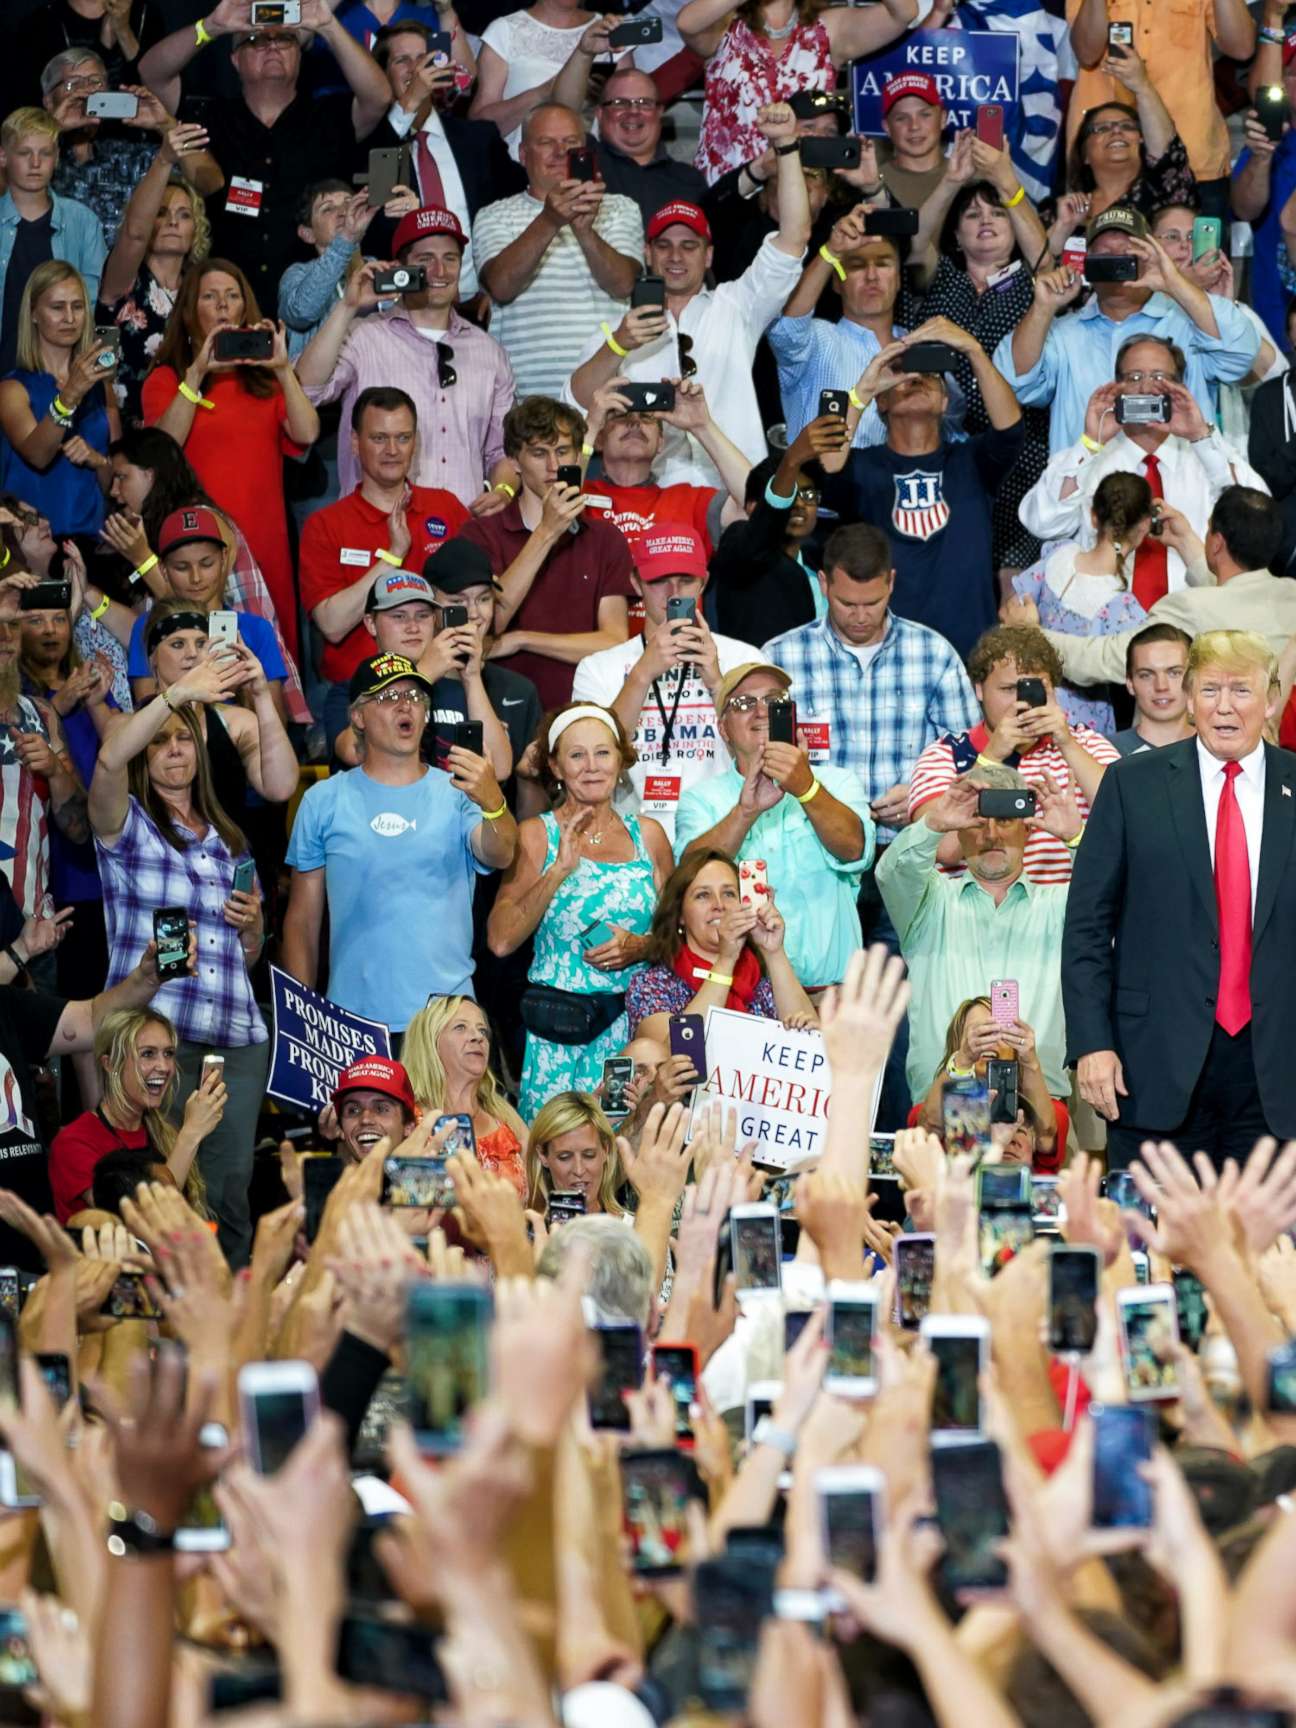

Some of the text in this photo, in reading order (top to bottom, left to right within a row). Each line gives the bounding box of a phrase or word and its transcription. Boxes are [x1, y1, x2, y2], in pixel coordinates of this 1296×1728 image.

[907, 46, 966, 65] KEEP
[860, 72, 1013, 101] ARICA
[183, 511, 199, 530] E
[646, 535, 696, 548] MAKE AMERICA
[648, 546, 672, 555] GREAT
[284, 987, 377, 1055] PROMISES
[762, 1042, 825, 1073] KEEP
[364, 1062, 394, 1076] AMERICA
[368, 1069, 391, 1080] AGAIN
[702, 1065, 832, 1121] AMERI
[741, 1116, 818, 1151] GREAT
